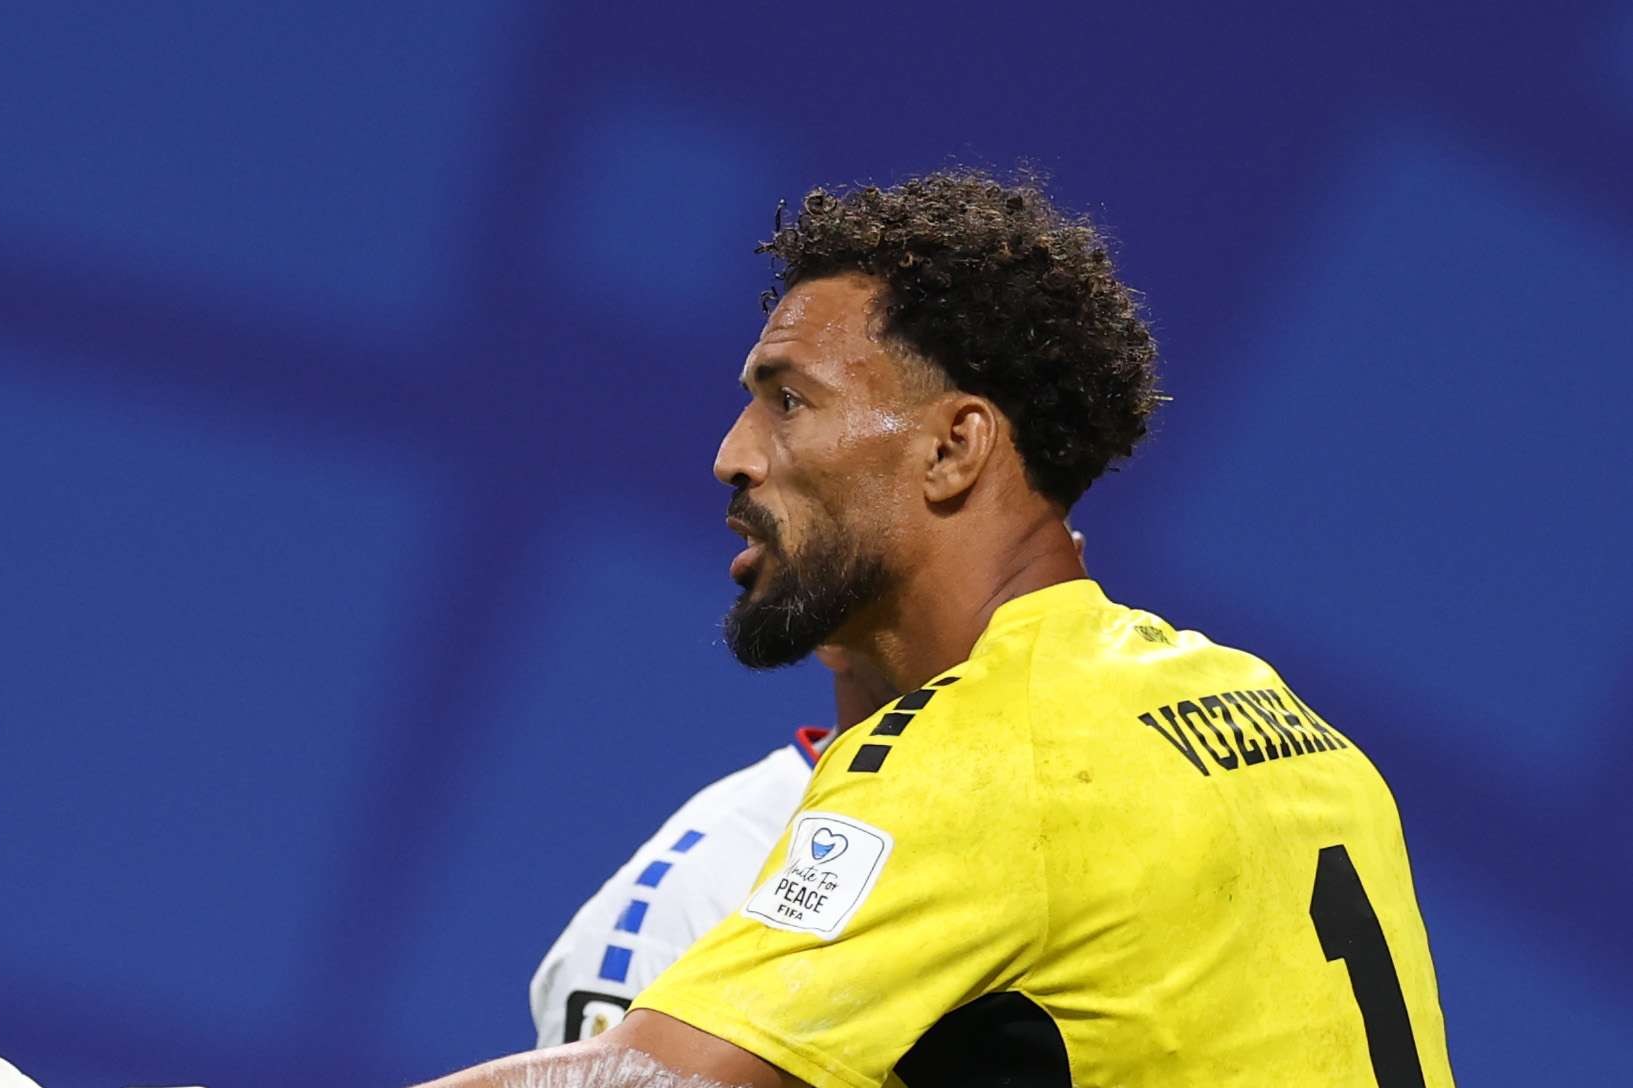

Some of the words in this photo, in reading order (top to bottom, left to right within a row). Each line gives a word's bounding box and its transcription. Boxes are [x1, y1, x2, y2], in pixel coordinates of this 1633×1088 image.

[1137, 687, 1348, 776] VOZINHA
[775, 878, 828, 913] PEACE
[777, 904, 803, 920] FIFA
